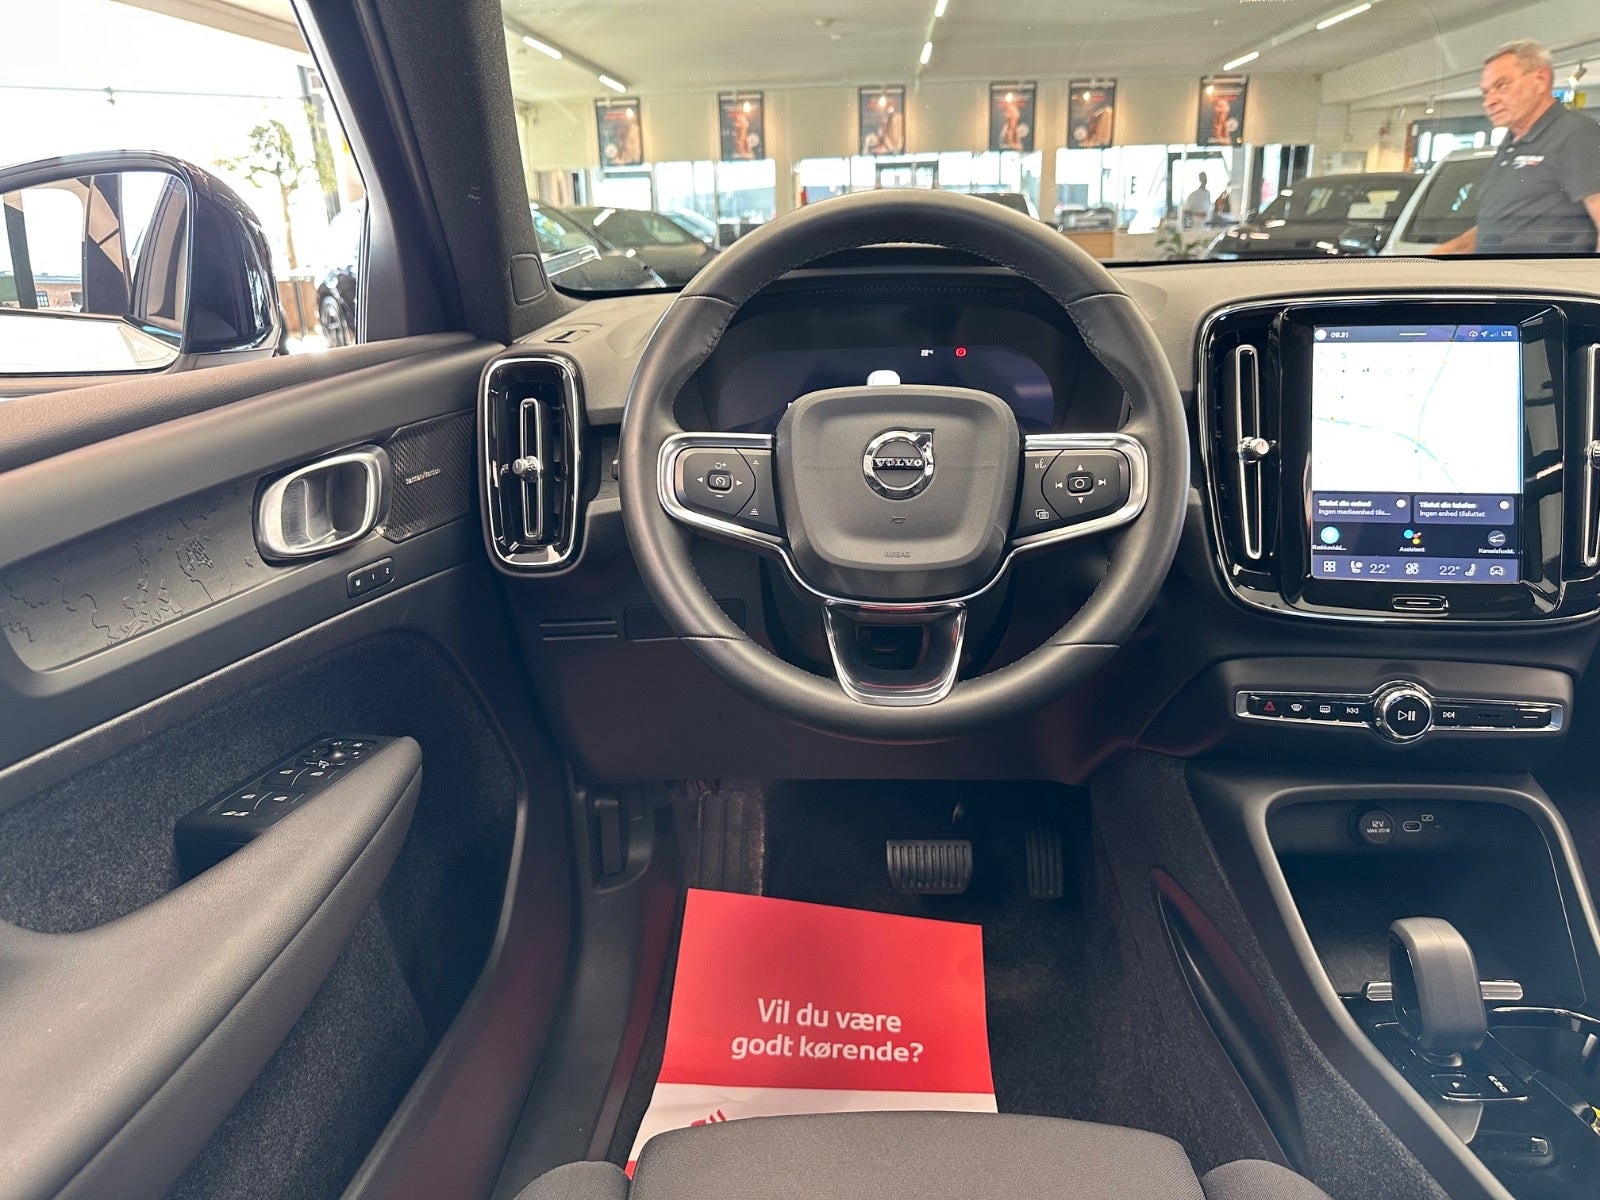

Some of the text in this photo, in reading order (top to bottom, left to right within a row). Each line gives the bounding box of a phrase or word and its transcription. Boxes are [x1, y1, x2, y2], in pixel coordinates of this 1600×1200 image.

[875, 457, 923, 468] VOLVO
[1318, 508, 1336, 516] Ingen
[1419, 510, 1438, 518] Ingen
[1369, 562, 1391, 574] 22°
[1439, 565, 1460, 576] 22°
[757, 997, 902, 1033] Vil du være
[731, 1033, 924, 1063] godt kørende?
